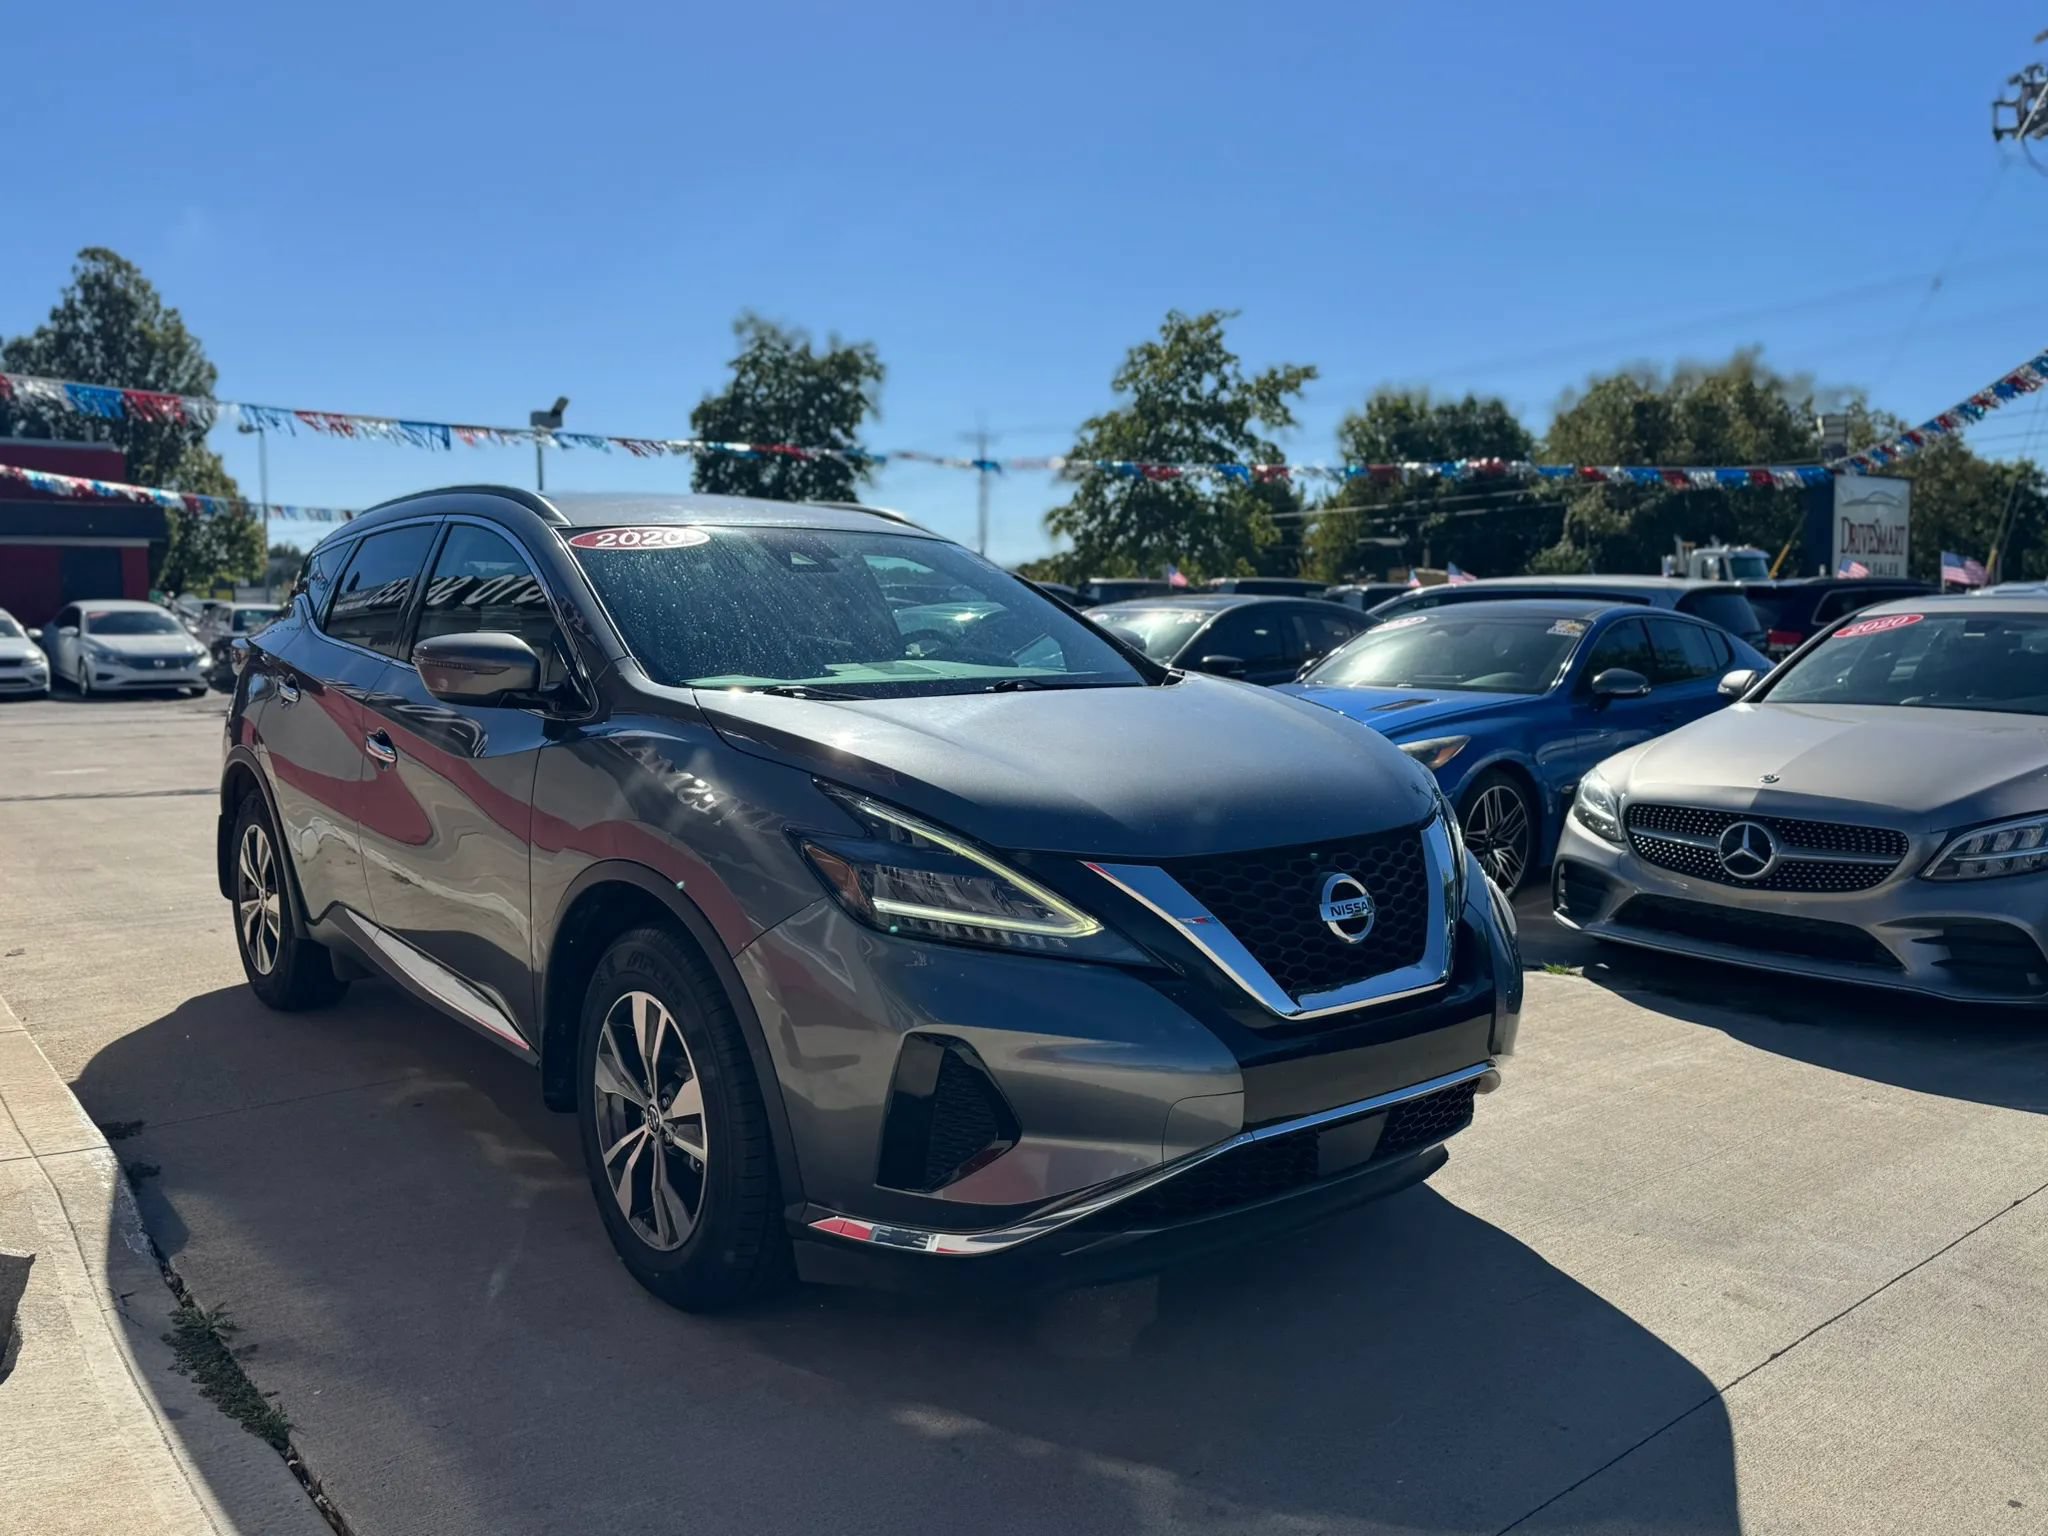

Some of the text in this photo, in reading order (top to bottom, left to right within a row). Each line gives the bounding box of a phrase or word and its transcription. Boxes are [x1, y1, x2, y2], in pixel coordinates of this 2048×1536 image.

[595, 531, 685, 547] 2020
[1847, 616, 1909, 635] 2020
[1331, 899, 1373, 917] NISSA
